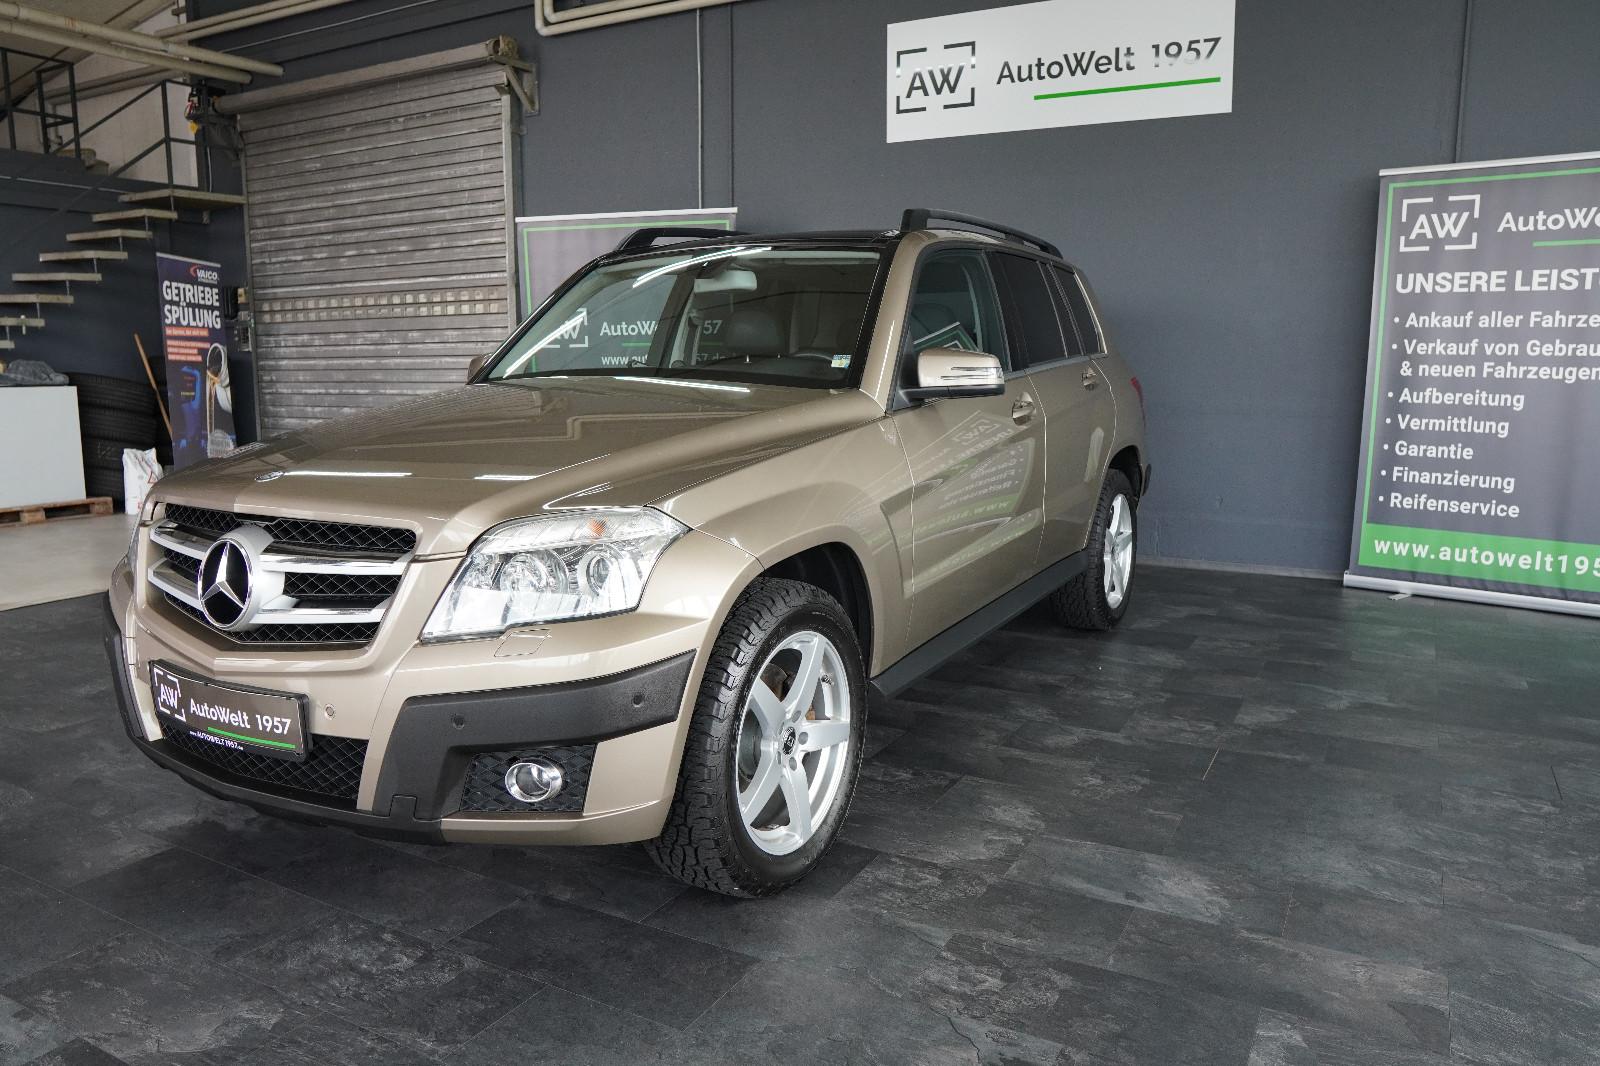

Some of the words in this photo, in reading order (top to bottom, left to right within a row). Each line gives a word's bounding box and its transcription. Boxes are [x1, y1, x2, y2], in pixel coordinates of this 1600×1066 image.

[996, 46, 1136, 85] AutoWelt
[1151, 36, 1223, 68] 1957
[905, 63, 966, 99] AW
[1409, 211, 1470, 240] AW
[196, 268, 218, 280] VAICO
[1396, 270, 1507, 294] UNSERE
[1514, 268, 1600, 292] LEIST
[162, 280, 220, 307] GETRIEBE
[164, 301, 221, 330] SPÜLUNG
[599, 320, 659, 337] AutoW
[1405, 311, 1474, 328] Ankauf
[1478, 311, 1524, 328] aller
[1529, 311, 1600, 328] Fahrze
[1404, 338, 1479, 356] Verkauf
[1484, 342, 1519, 356] von
[1526, 339, 1600, 357] Gebrau
[1400, 361, 1412, 377] &
[1418, 362, 1476, 378] neuen
[1482, 362, 1600, 384] Fahrzeugen
[1399, 388, 1525, 411] Aufbereitung
[1397, 413, 1510, 438] Vermittlung
[1394, 440, 1474, 460] Garantie
[1392, 466, 1516, 493] Finanzierung
[1390, 492, 1520, 518] Reifenservice
[160, 683, 178, 709] AW
[190, 698, 251, 729] AutoWelt
[256, 714, 292, 735] 1957
